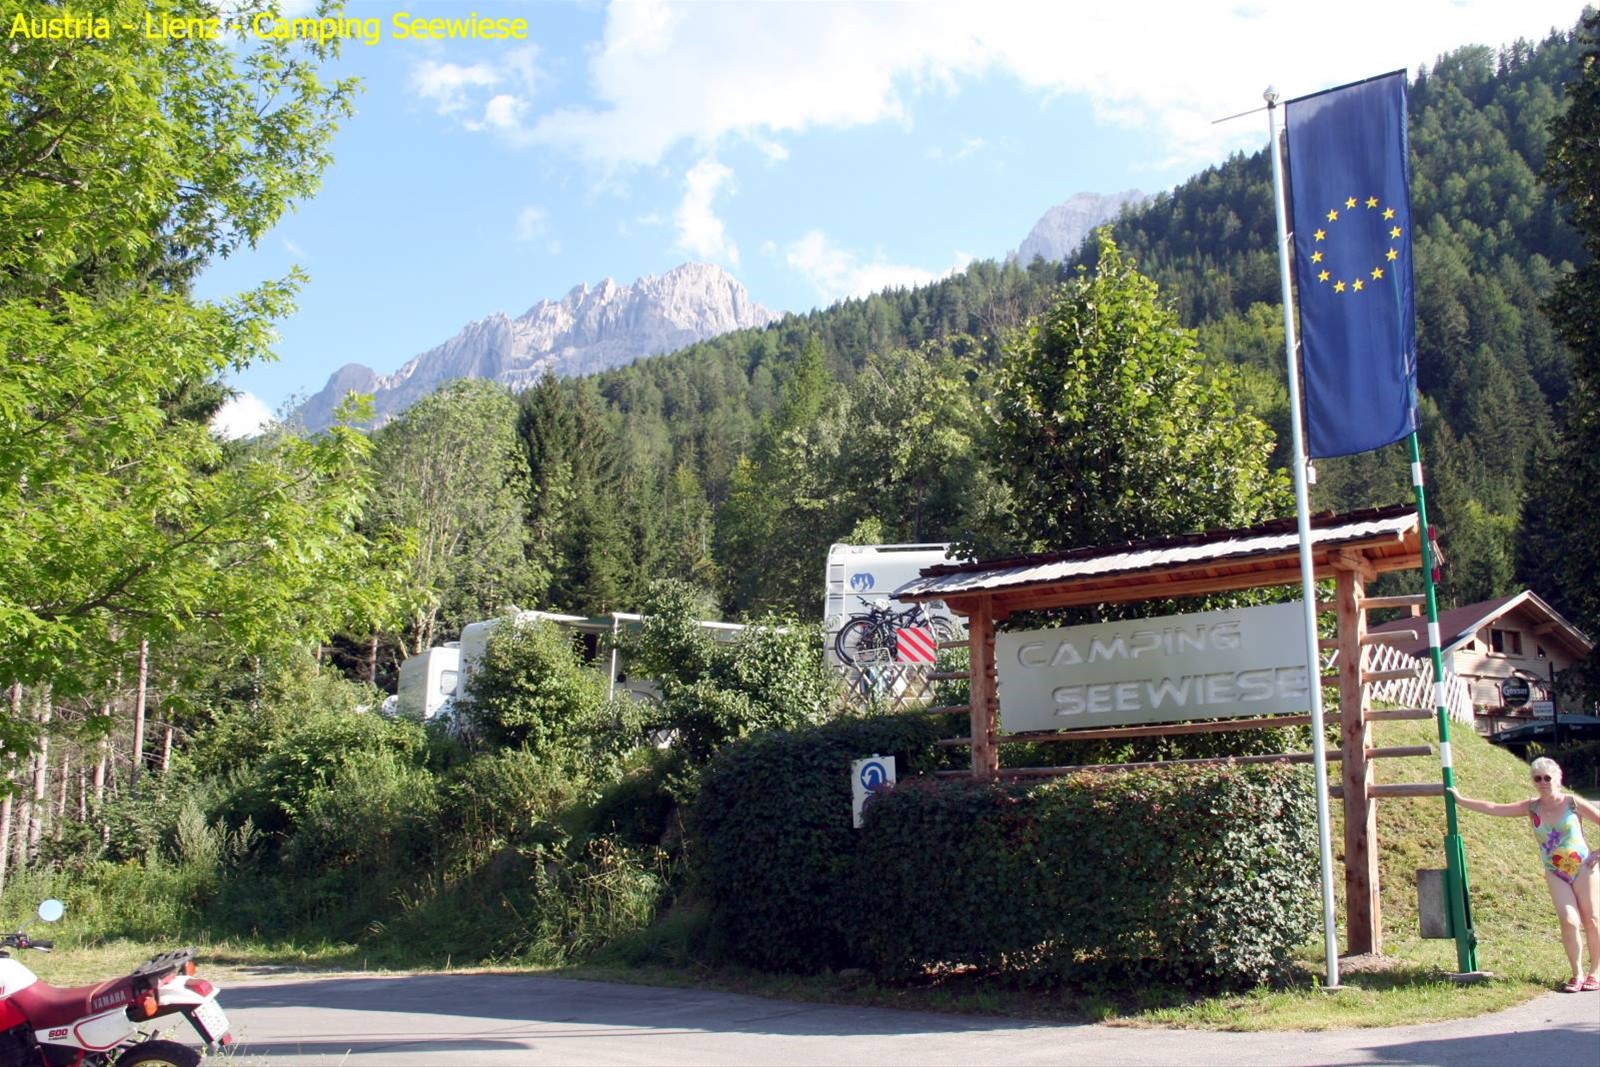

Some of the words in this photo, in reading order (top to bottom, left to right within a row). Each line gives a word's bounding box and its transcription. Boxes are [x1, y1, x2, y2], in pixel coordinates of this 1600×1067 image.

[1018, 621, 1241, 668] CAMPING
[1052, 664, 1308, 716] SEEWIESE
[93, 991, 126, 1009] YAMAHA
[48, 1028, 68, 1038] 600
